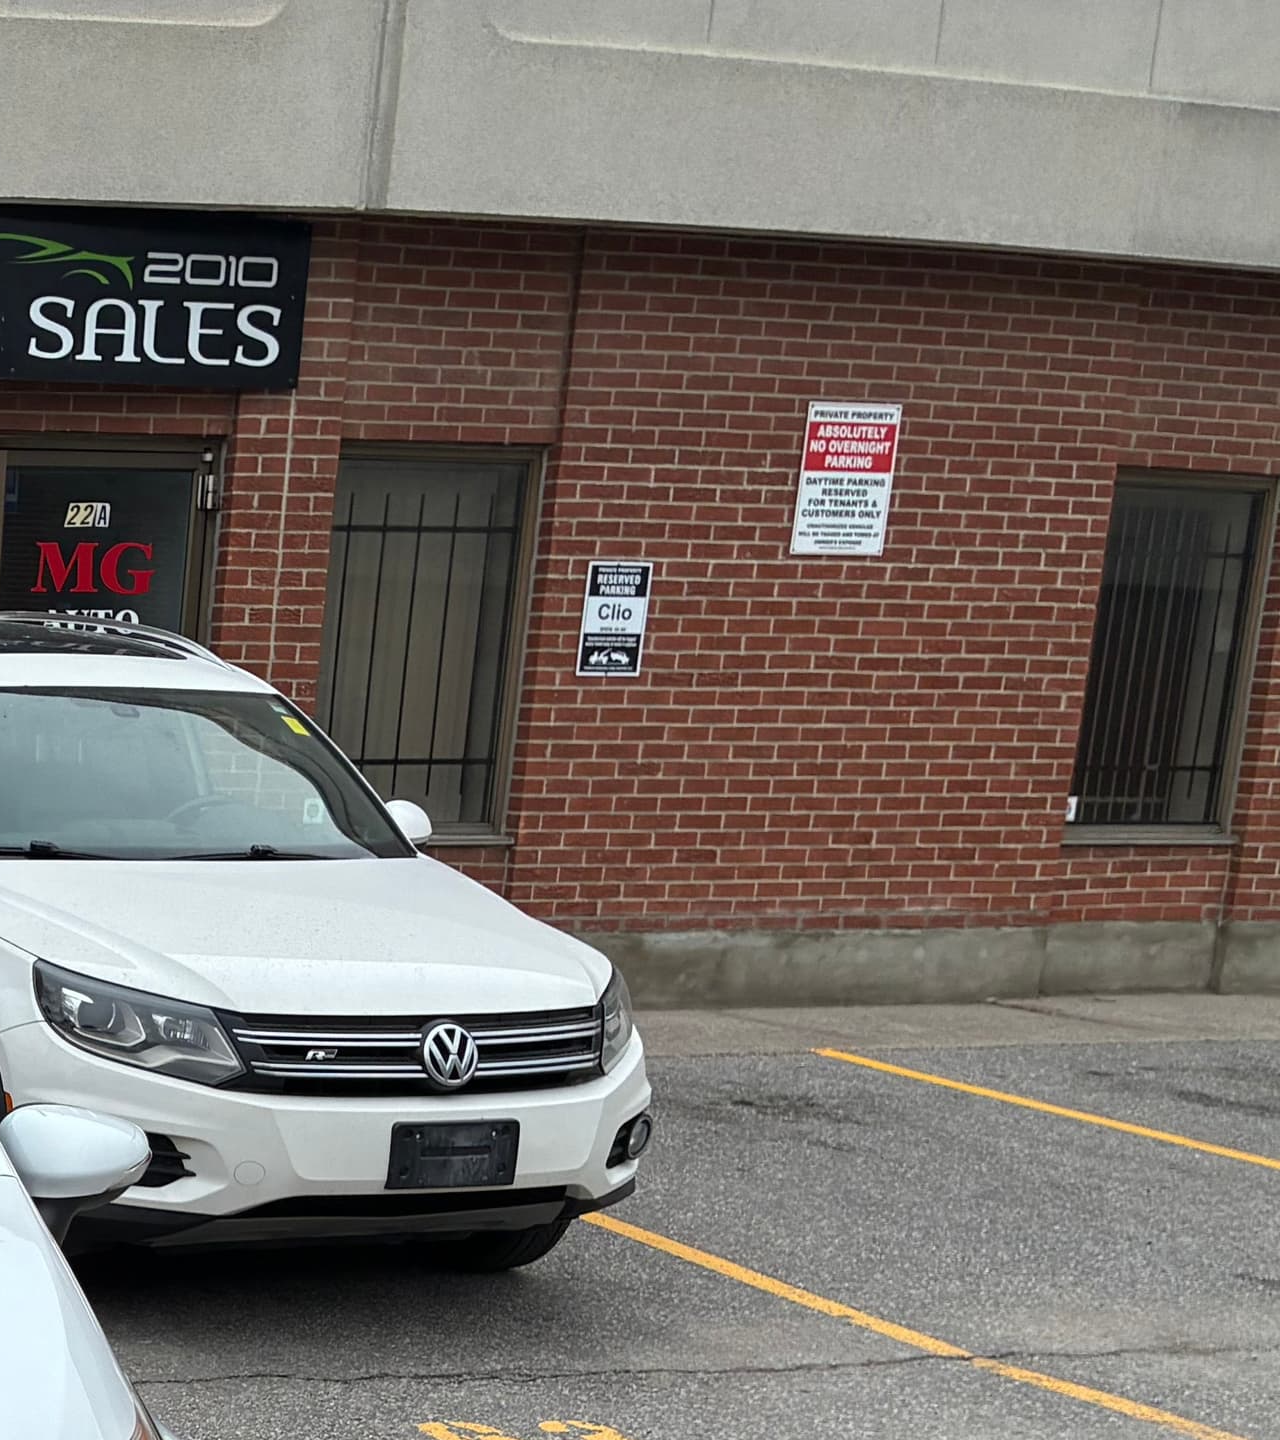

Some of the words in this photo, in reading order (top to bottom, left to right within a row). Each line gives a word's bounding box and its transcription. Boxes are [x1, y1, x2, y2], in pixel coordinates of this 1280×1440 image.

[142, 251, 280, 290] 2010
[27, 295, 283, 368] SALES
[814, 410, 849, 419] PRIVATE
[851, 411, 895, 421] PROPERTY
[817, 425, 888, 439] ABSOLUTELY
[809, 440, 826, 453] NO
[828, 441, 891, 455] OVERNIGHT
[824, 456, 873, 469] PARKING
[806, 477, 845, 486] DAYTIME
[846, 478, 886, 487] PARKING
[821, 488, 868, 497] RESERVED
[808, 499, 827, 507] FOR
[828, 500, 869, 508] TENANTS
[67, 503, 108, 527] 22A
[801, 509, 856, 518] CUSTOMERS
[858, 510, 882, 519] ONLY
[30, 541, 157, 596] MG
[597, 574, 642, 585] RESERVED
[599, 585, 636, 596] PARKING
[598, 604, 632, 620] Clio
